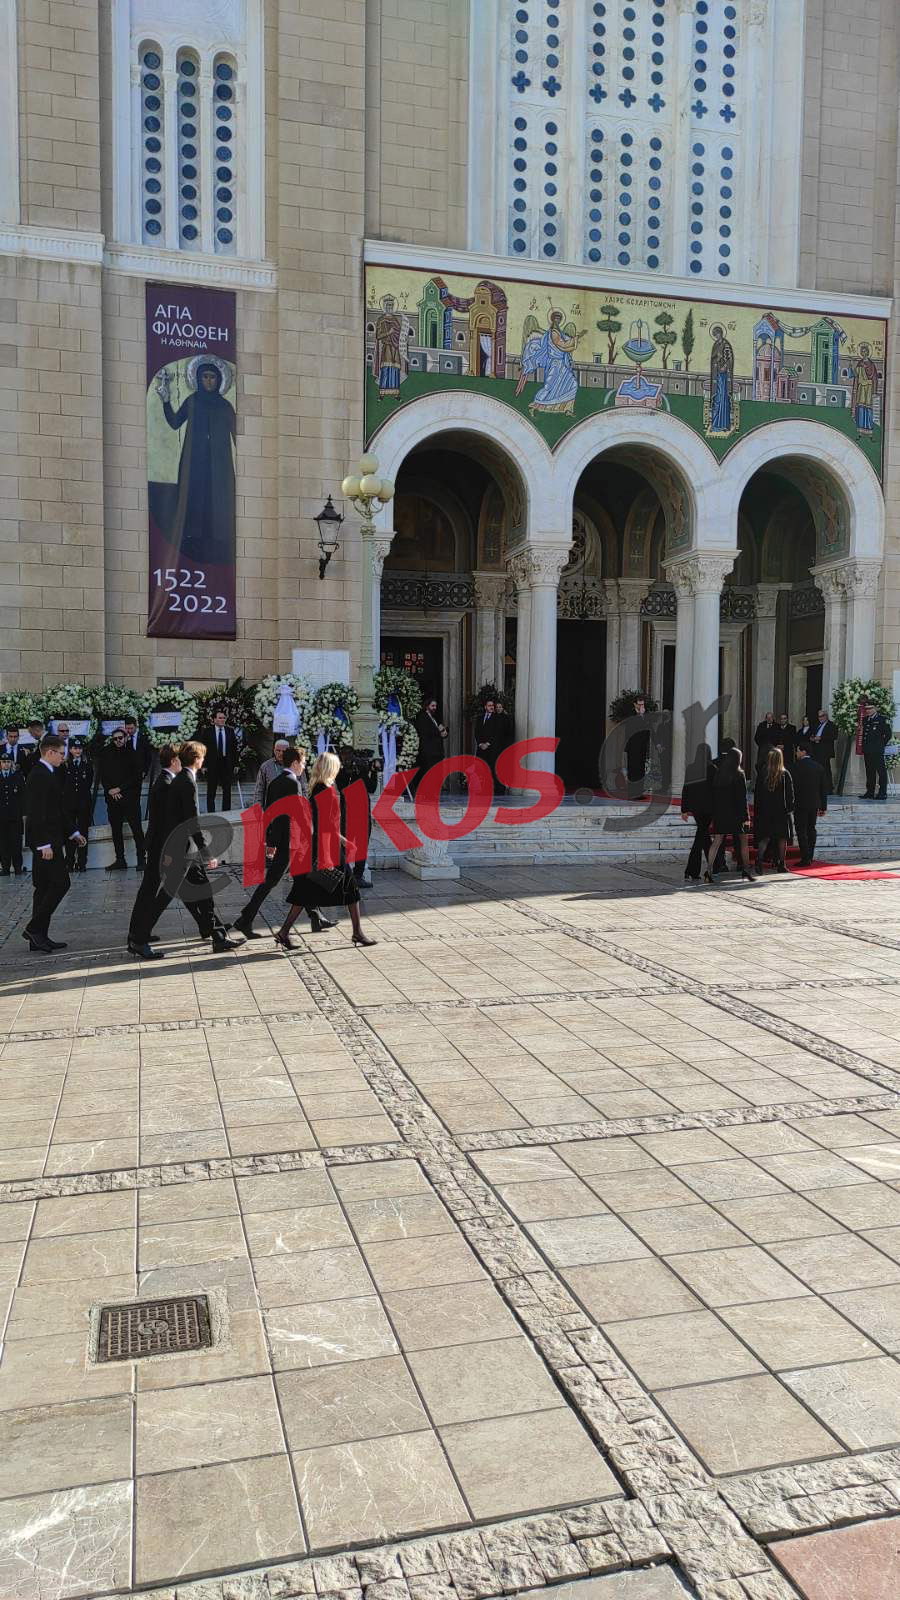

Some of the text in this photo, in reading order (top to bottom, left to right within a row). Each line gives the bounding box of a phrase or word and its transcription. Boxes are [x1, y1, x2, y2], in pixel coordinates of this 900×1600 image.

[155, 304, 192, 321] ΑΓΙΑ
[152, 321, 228, 342] ΦΙΛΟΘΕΗ
[168, 339, 207, 349] ΑΘΗΝΑΙΑ
[153, 568, 206, 592] 1522
[168, 593, 228, 614] 2022
